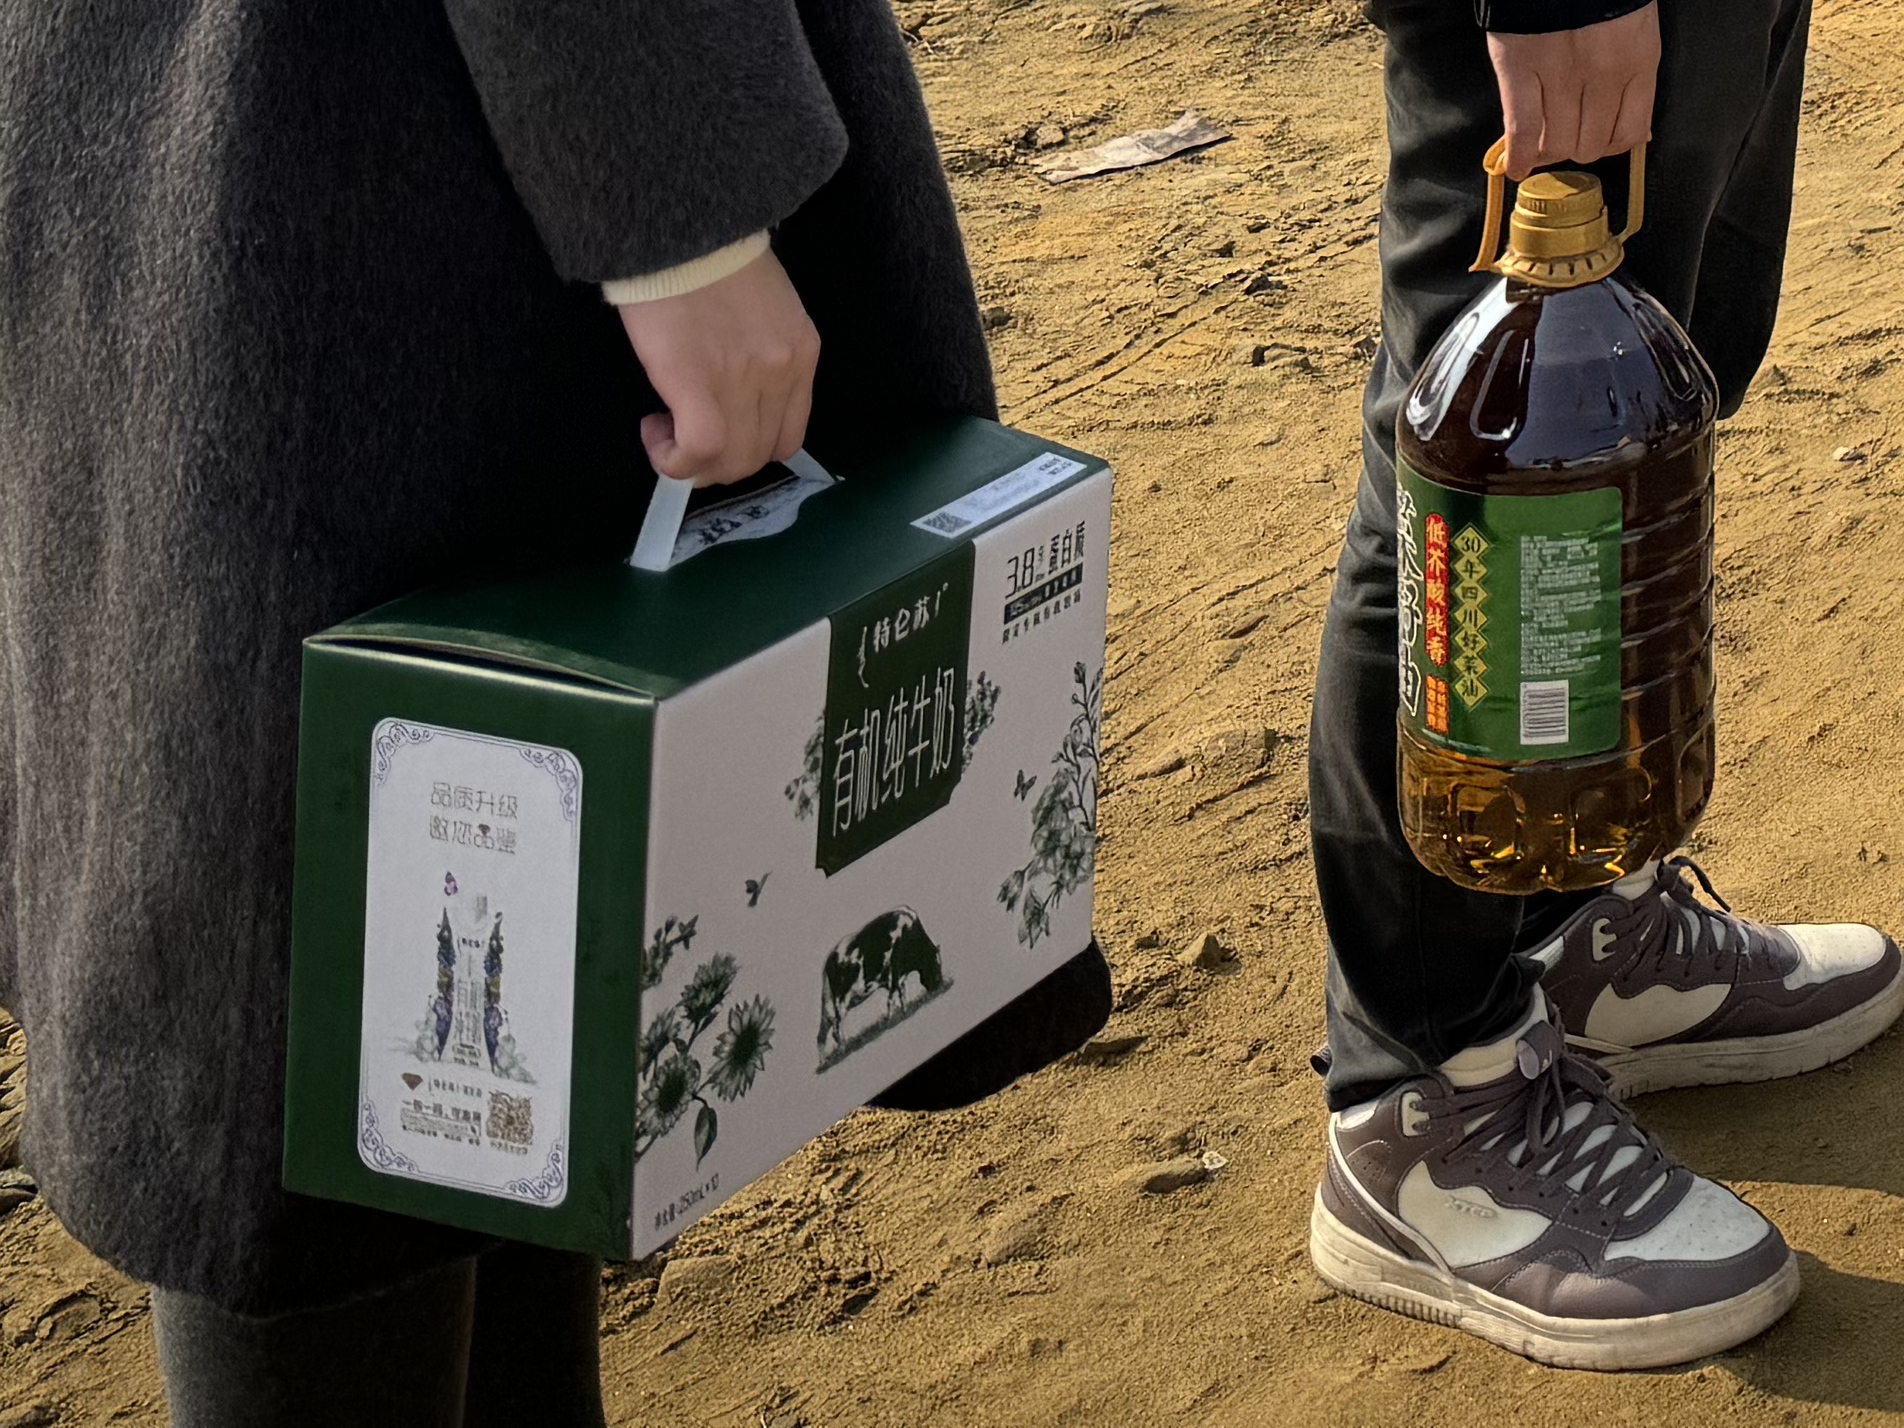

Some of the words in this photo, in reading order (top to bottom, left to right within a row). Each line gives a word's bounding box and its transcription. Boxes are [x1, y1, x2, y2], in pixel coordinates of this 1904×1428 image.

[873, 595, 931, 654] 特仑苏
[832, 667, 955, 838] 有机纯牛奶
[430, 781, 519, 821] 品质升级
